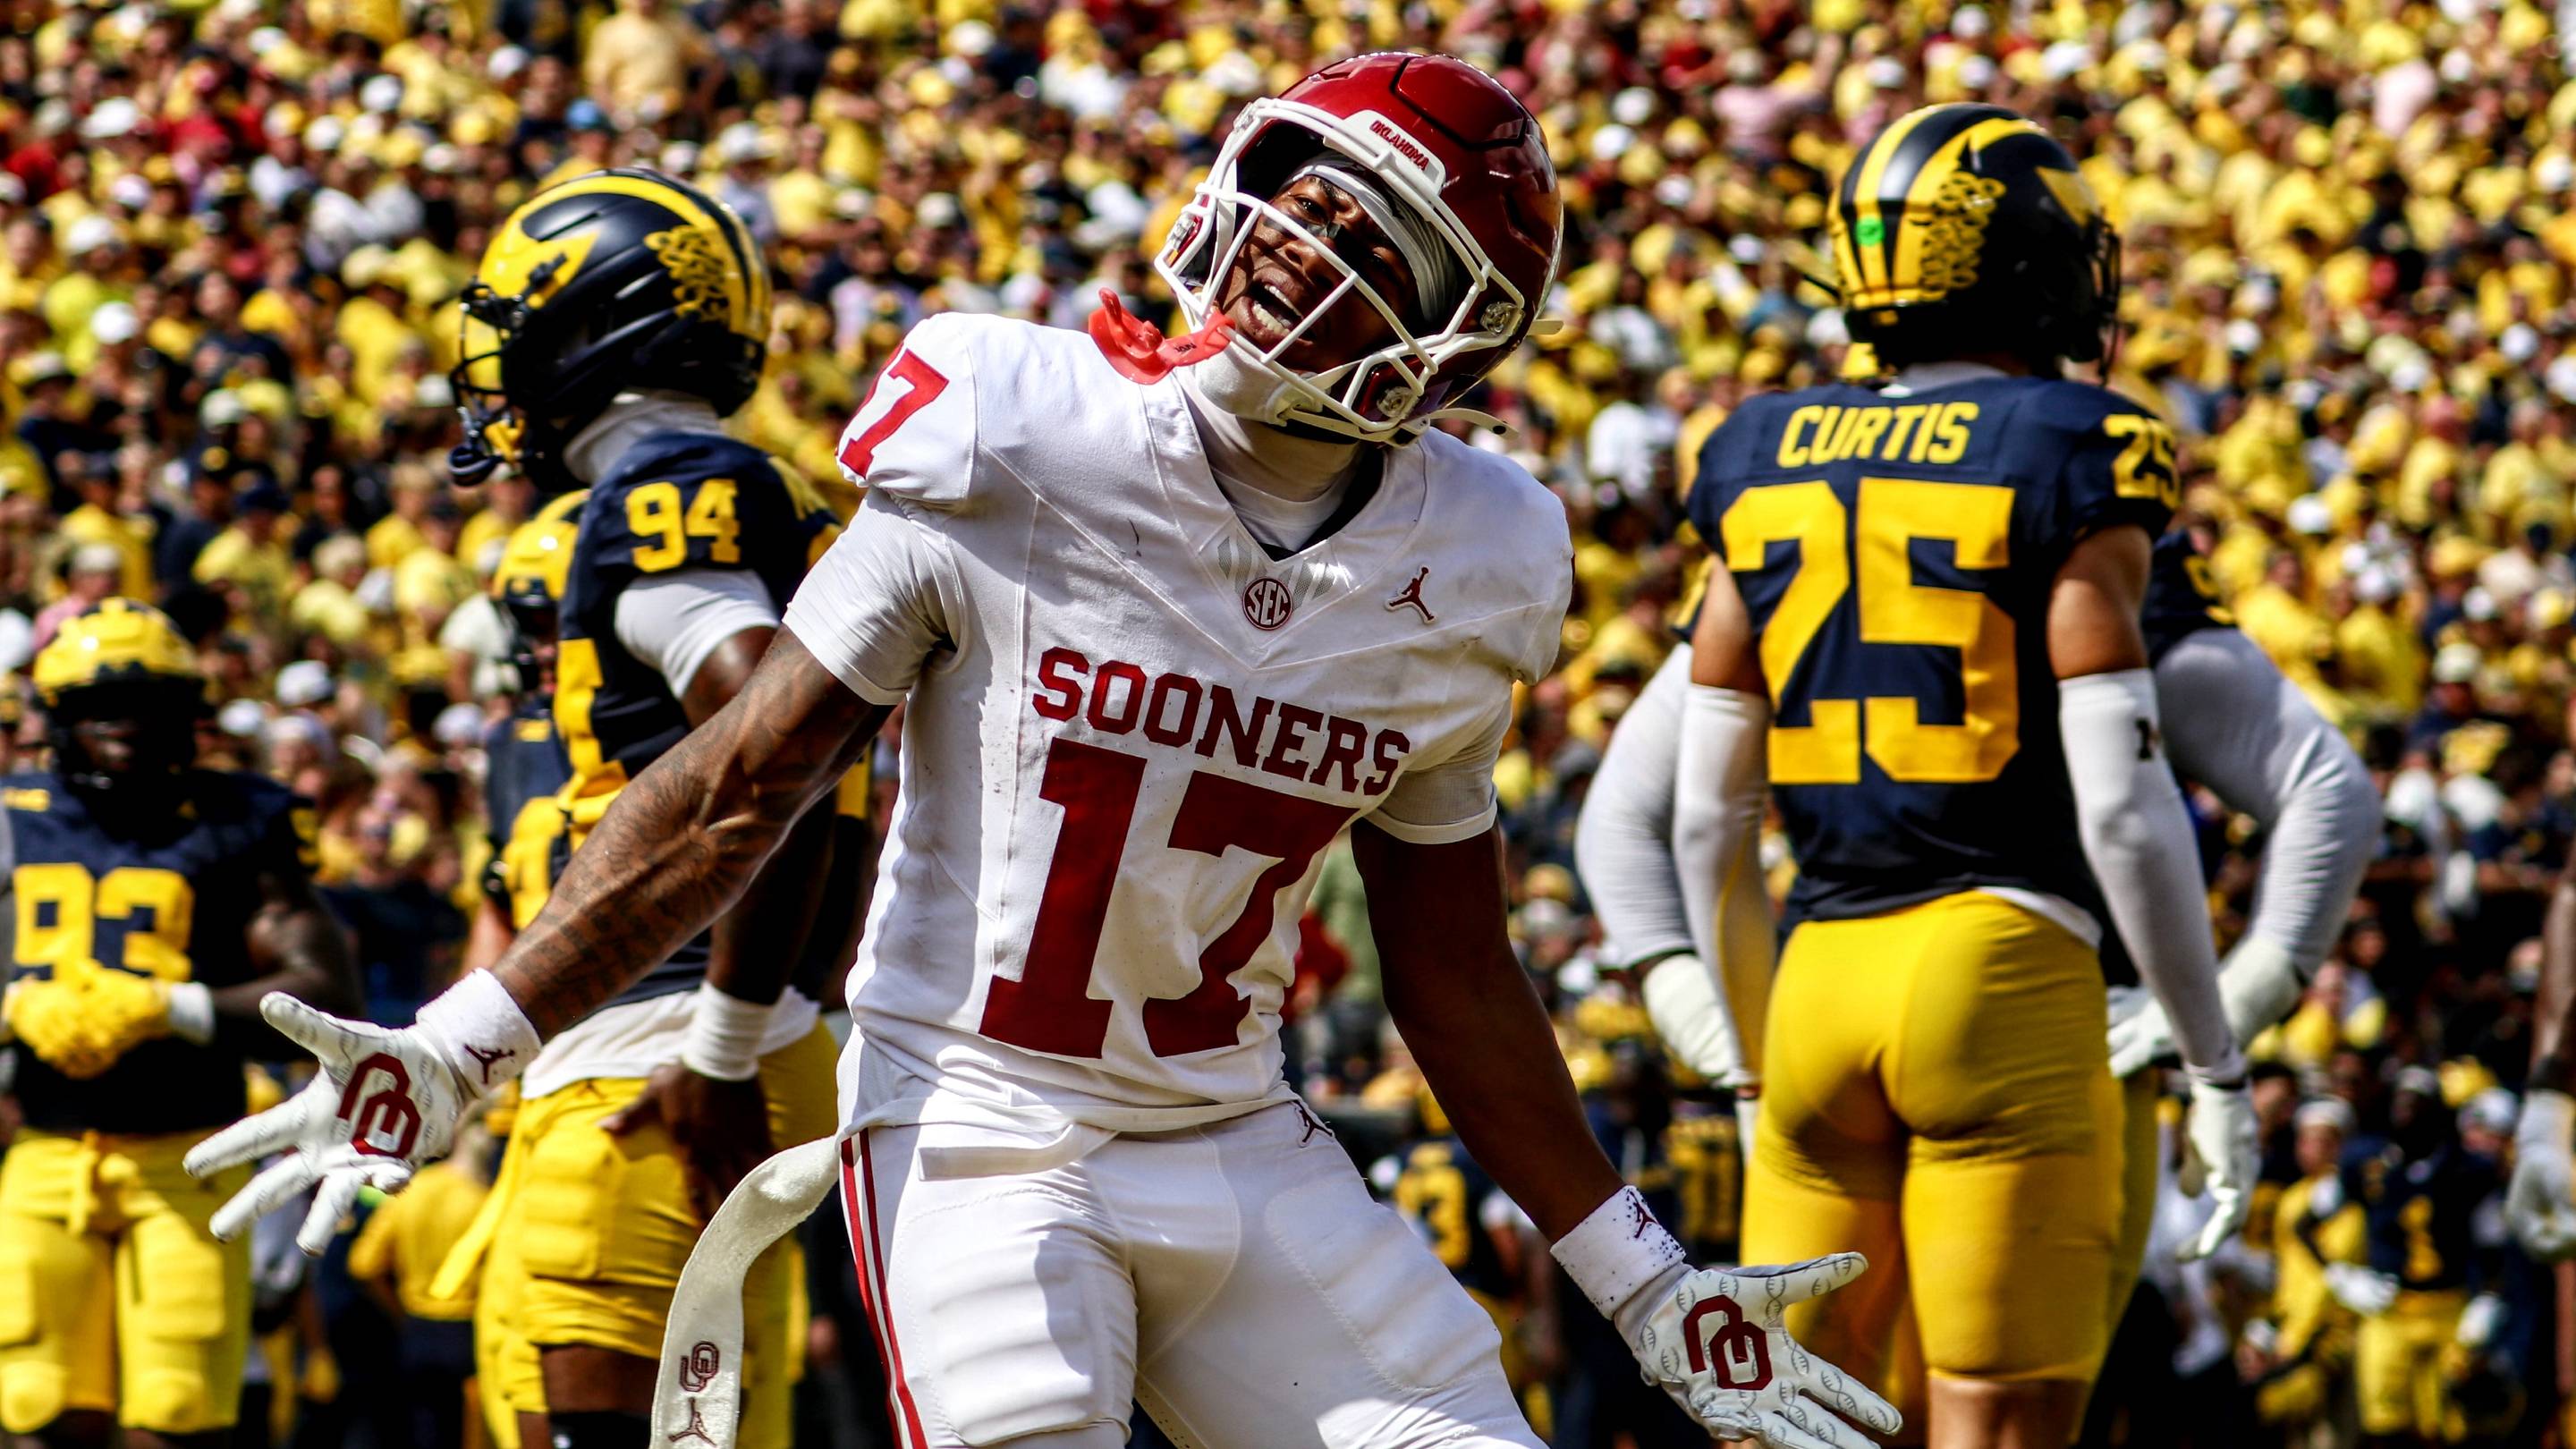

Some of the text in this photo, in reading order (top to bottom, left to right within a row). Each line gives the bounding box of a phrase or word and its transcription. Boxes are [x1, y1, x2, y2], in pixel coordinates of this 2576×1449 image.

[1369, 120, 1430, 171] OKLAHOMA
[1776, 402, 1979, 468] CURTIS
[2103, 414, 2181, 511] 25
[626, 478, 741, 572] 94
[1247, 580, 1289, 626] SEC
[1721, 477, 2020, 784] 25
[1032, 647, 1411, 796] SOONERS
[13, 862, 195, 983] 93
[979, 736, 1362, 1059] 17
[680, 1341, 720, 1392] OU
